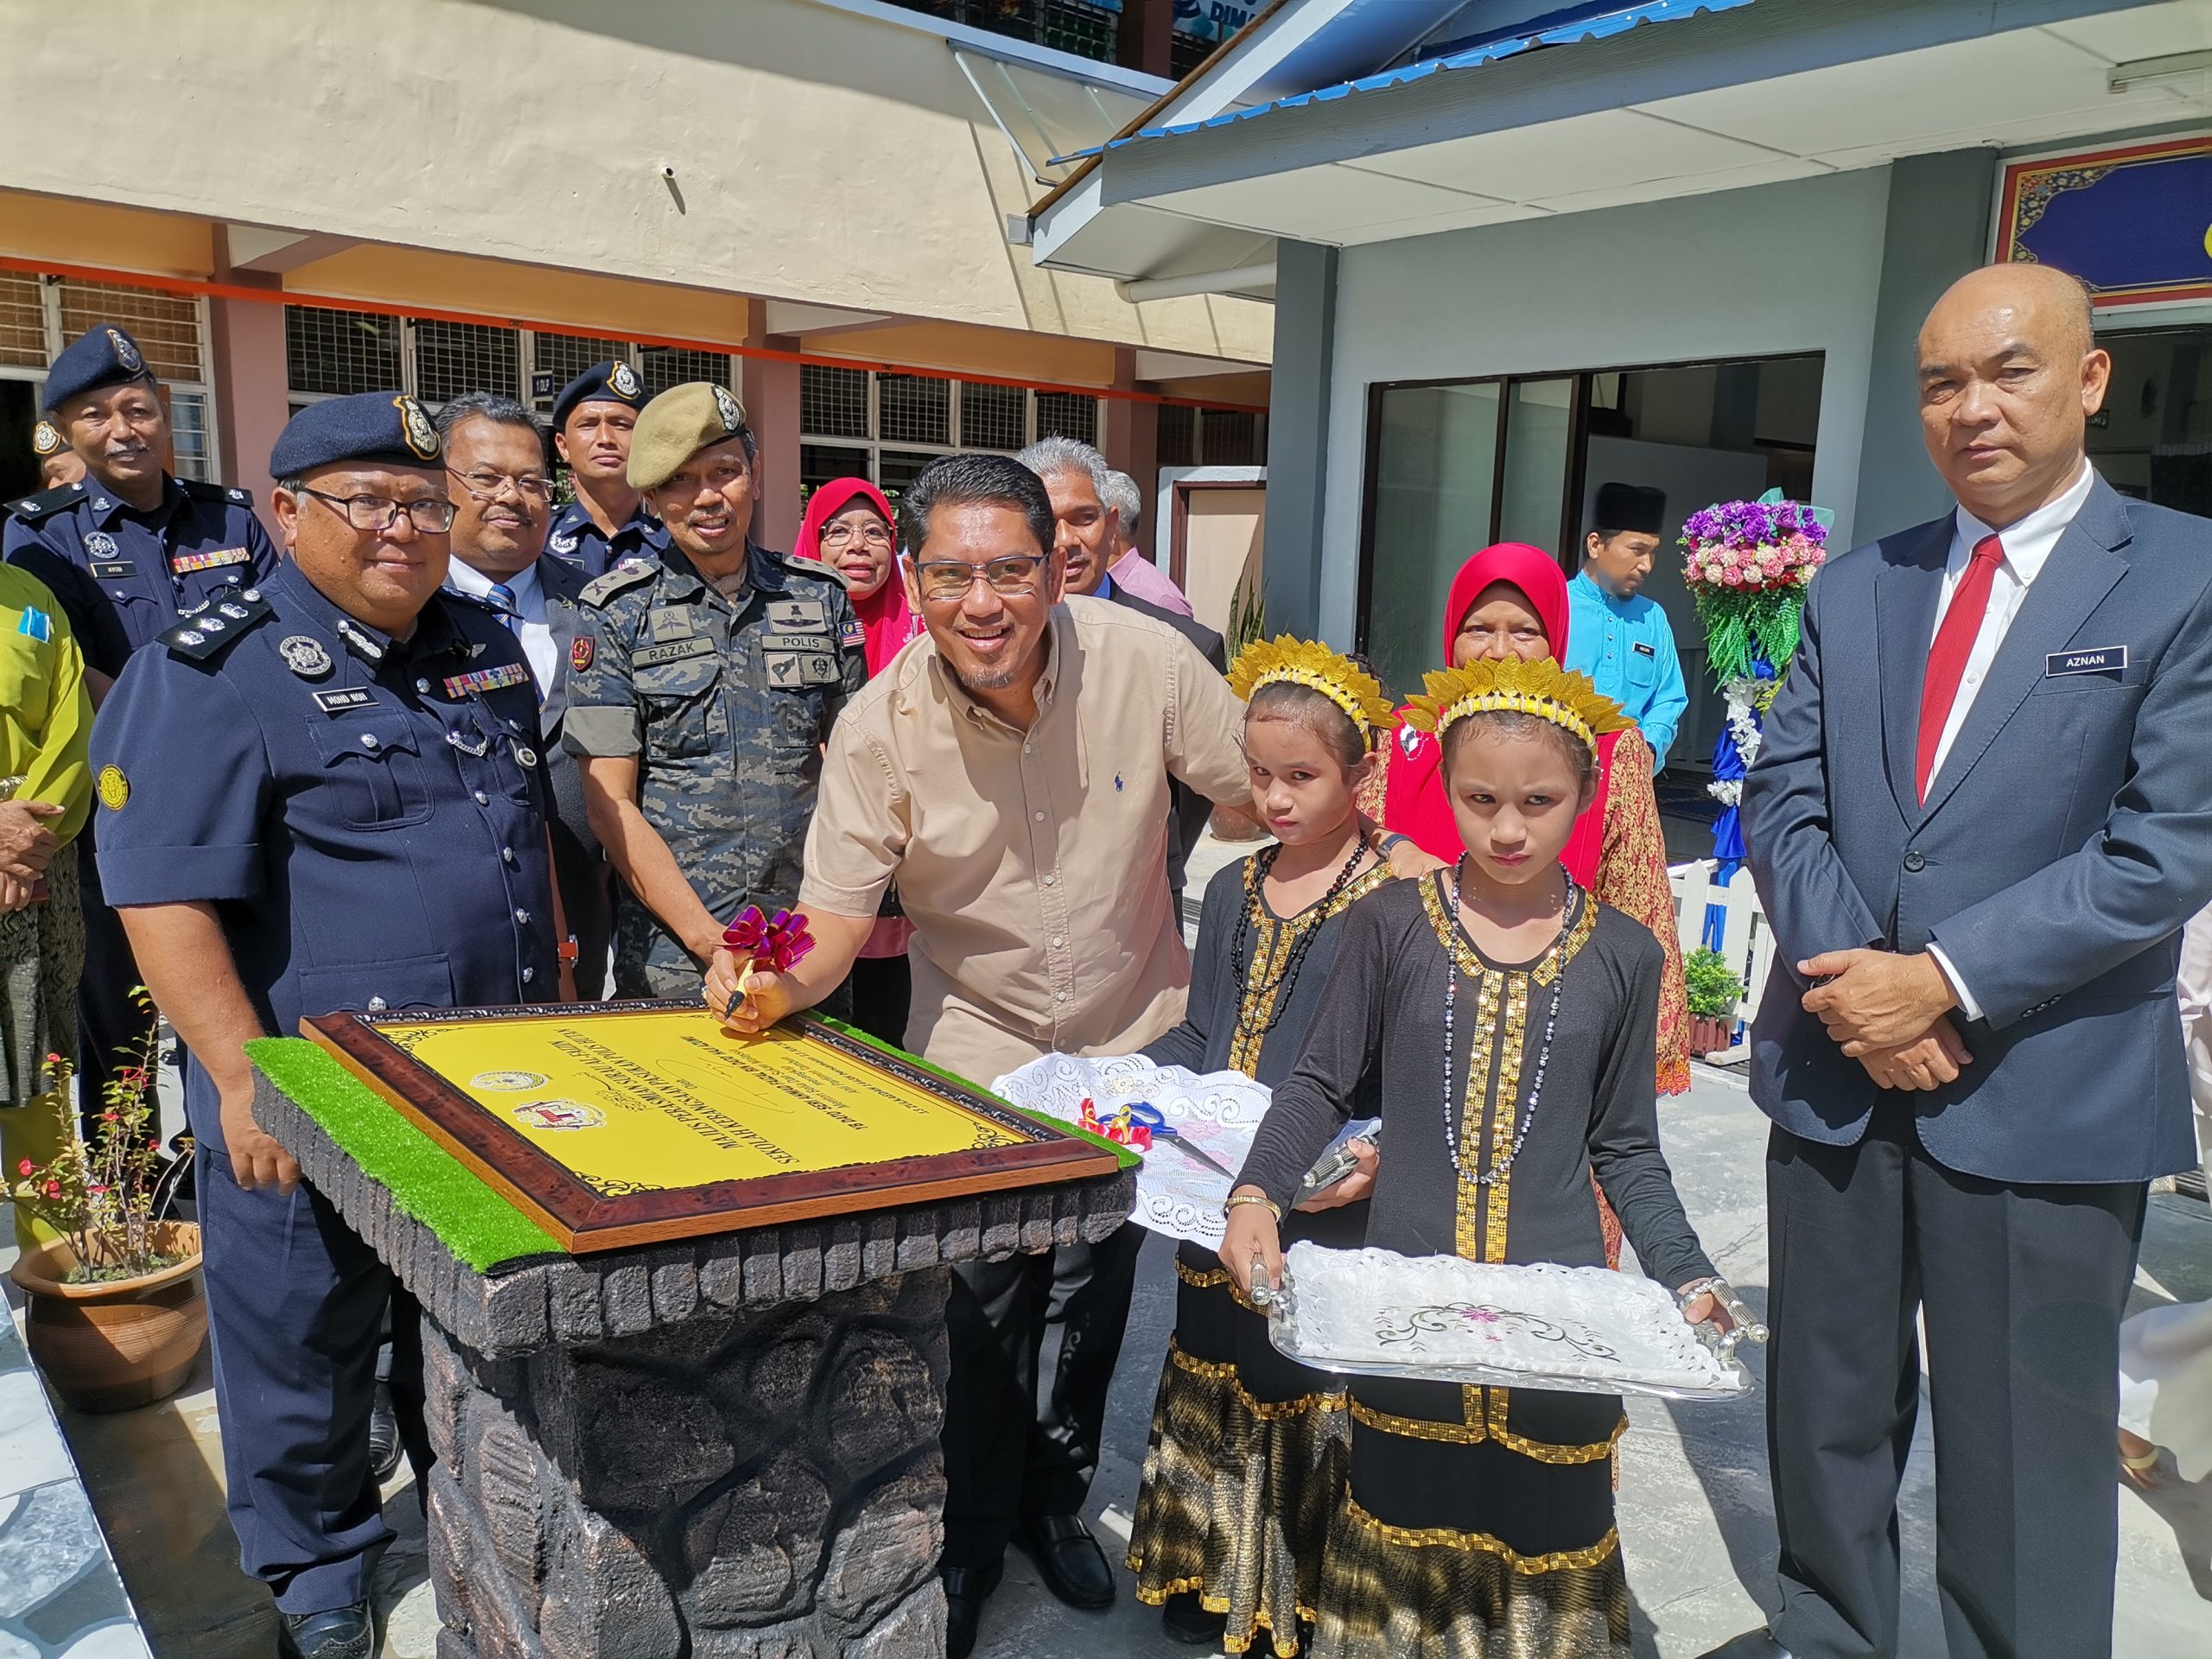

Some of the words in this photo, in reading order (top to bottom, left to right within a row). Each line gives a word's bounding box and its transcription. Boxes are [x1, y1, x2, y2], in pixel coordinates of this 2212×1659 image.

[1210, 1, 1257, 29] DIM
[782, 637, 820, 648] POLIS
[649, 642, 696, 661] RAZAK
[2066, 655, 2105, 667] AZNAN
[326, 694, 350, 705] MOHD
[555, 1028, 596, 1044] HUTAN
[549, 1040, 604, 1065] AL-FAIZIN
[584, 1044, 623, 1059] POLIS
[591, 1066, 637, 1084] SURAU
[612, 1059, 669, 1085] PASUKAN
[753, 1071, 784, 1085] FAIZAL
[777, 1085, 810, 1099] AHMAD
[626, 1085, 699, 1122] PERASMIAN
[661, 1086, 741, 1128] KEBANGSAAN
[804, 1100, 832, 1110] SERI
[824, 1111, 856, 1123] DATO'
[688, 1122, 742, 1149] MAJLIS
[731, 1129, 799, 1164] SEKOLAH
